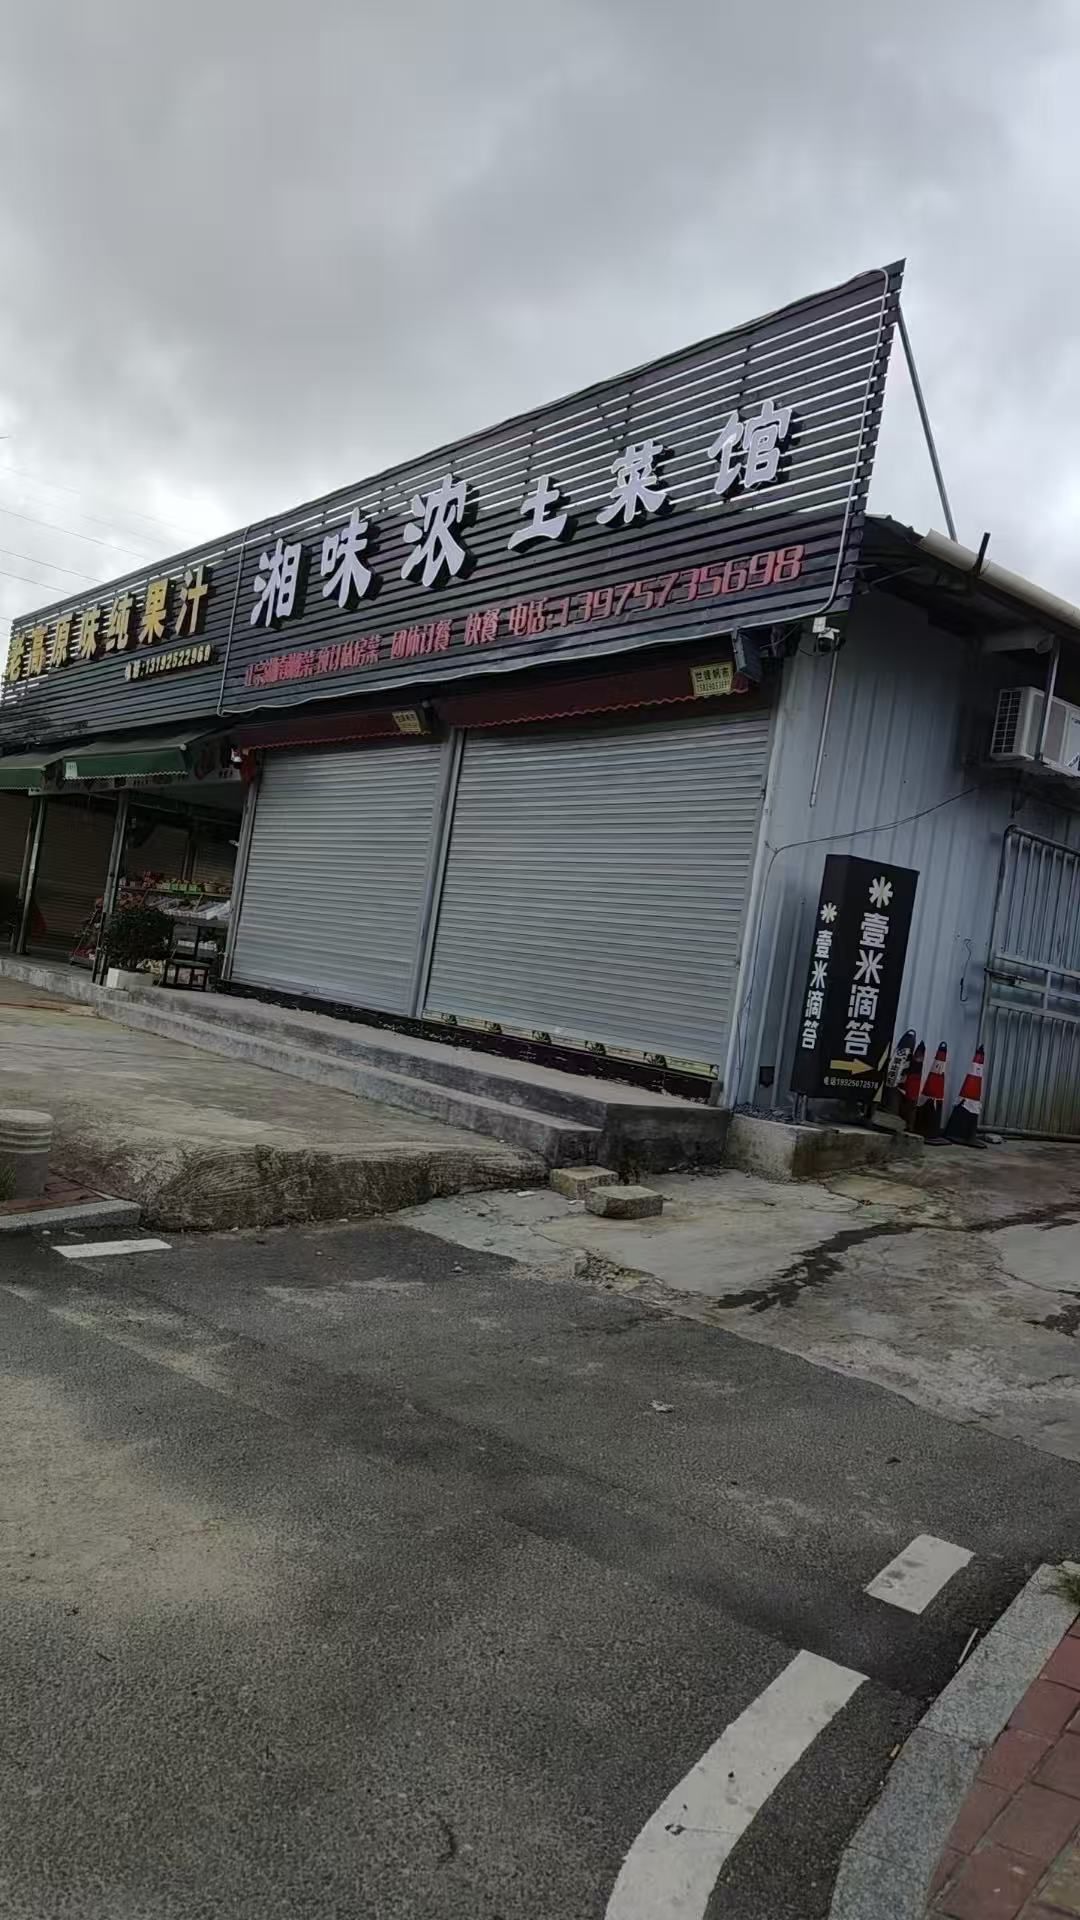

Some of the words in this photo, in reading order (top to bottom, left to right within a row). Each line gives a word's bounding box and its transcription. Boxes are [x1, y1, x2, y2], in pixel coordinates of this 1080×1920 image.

[249, 400, 793, 627] 湘味浓土菜馆
[801, 929, 833, 1050] 壹米滴答
[844, 912, 890, 1056] 壹米滴答
